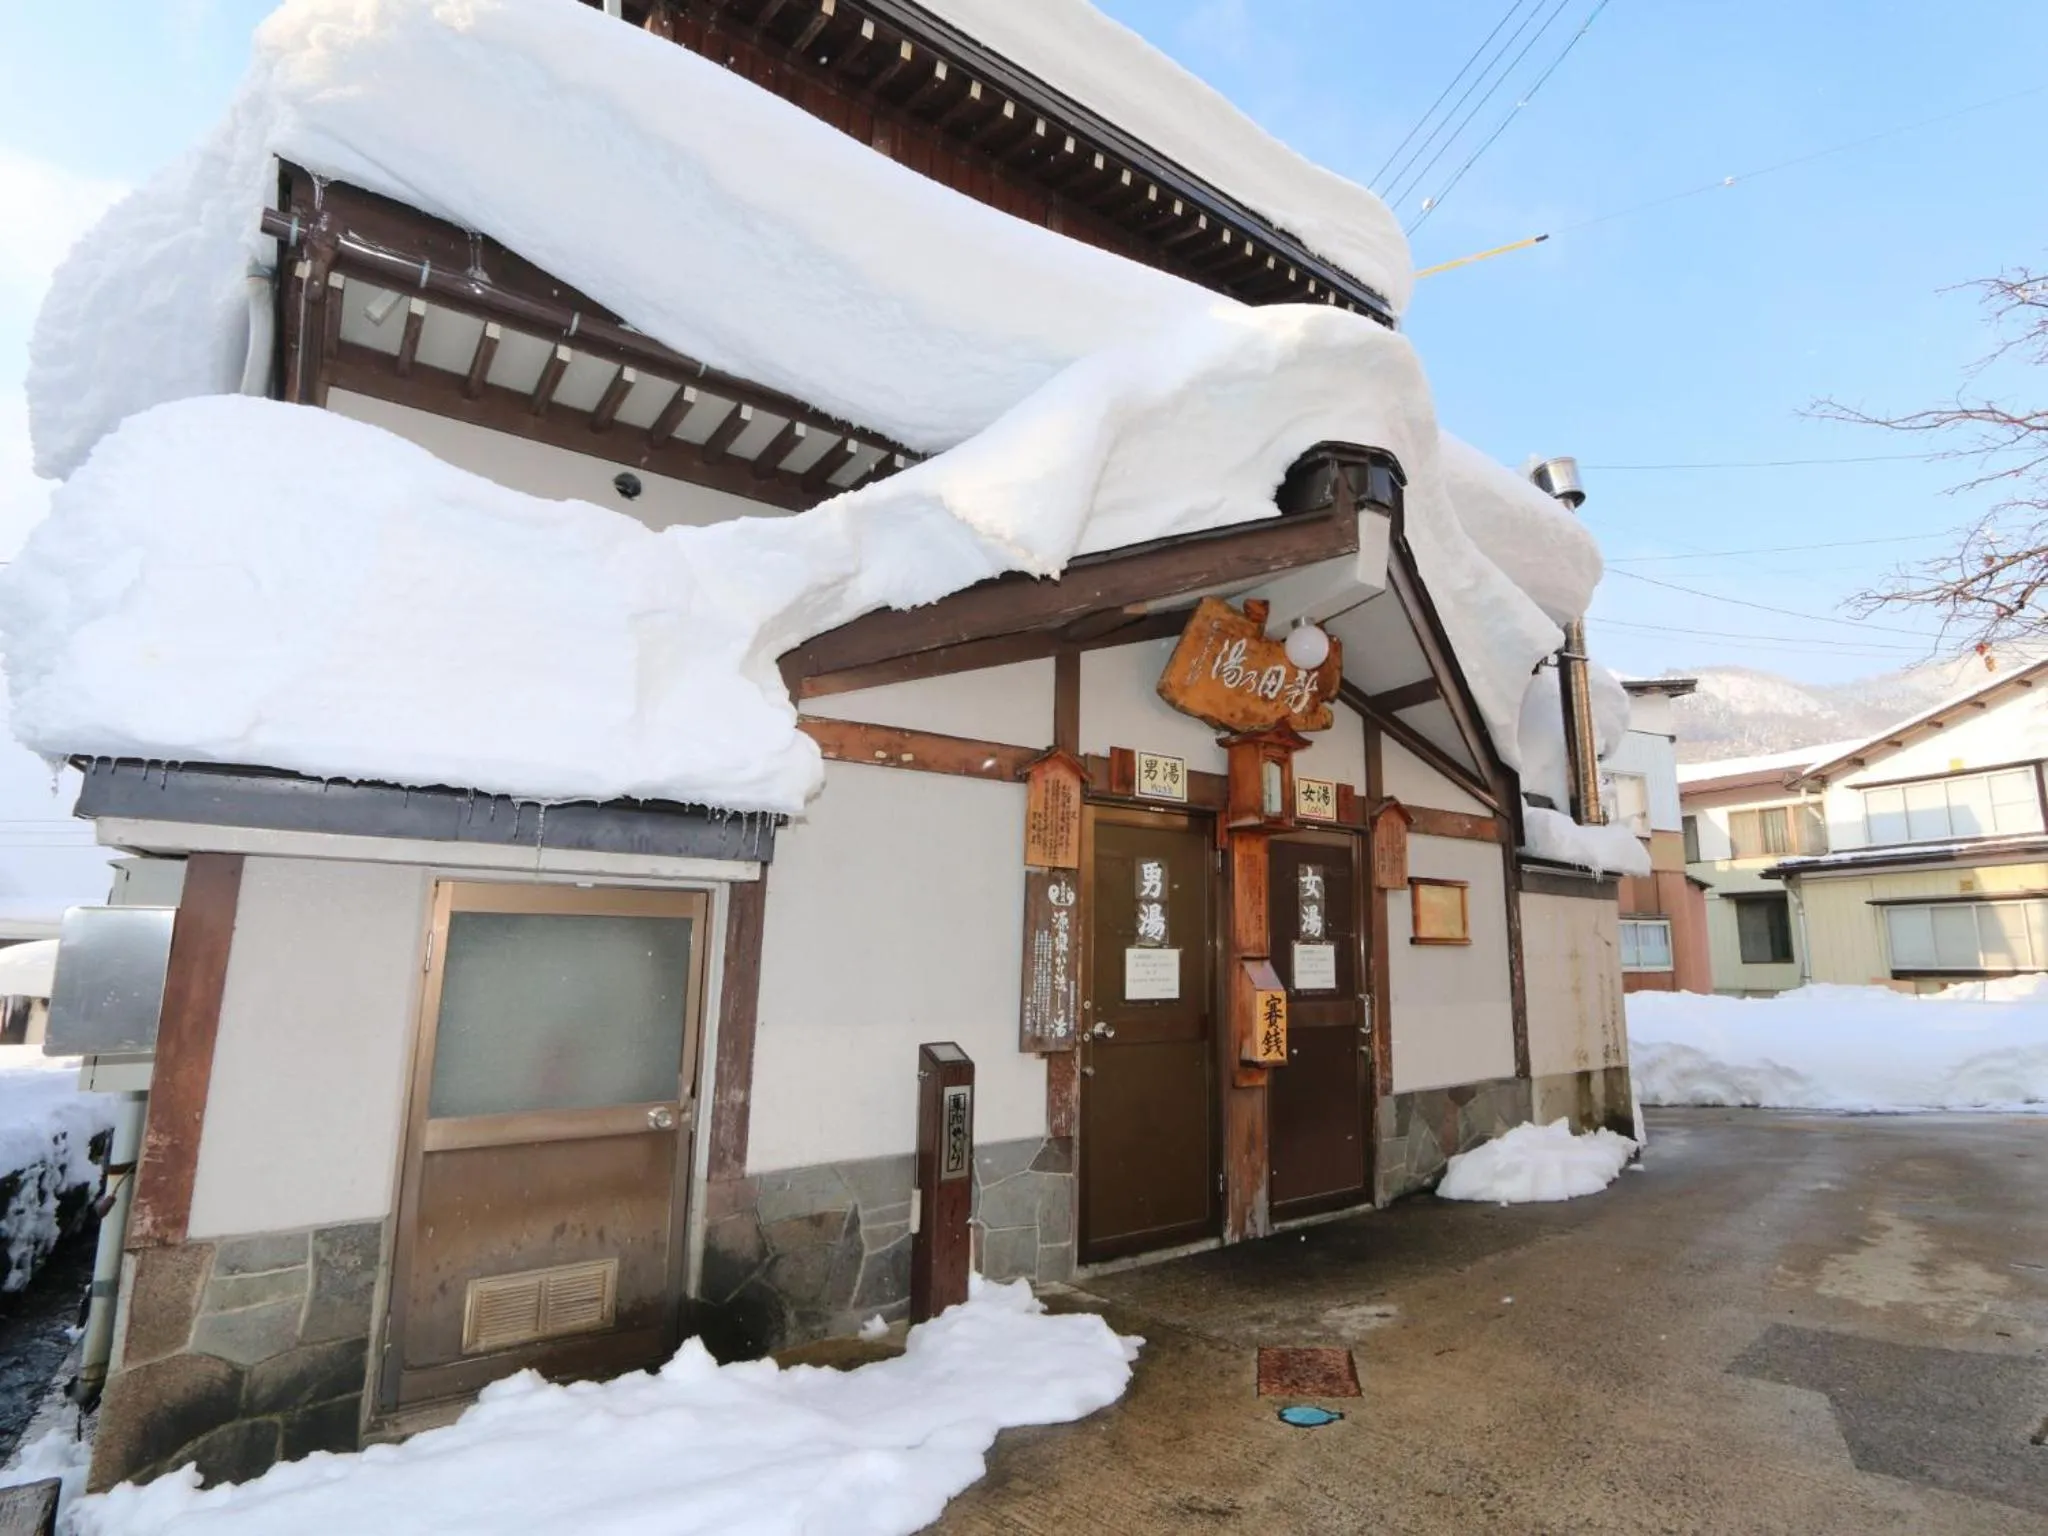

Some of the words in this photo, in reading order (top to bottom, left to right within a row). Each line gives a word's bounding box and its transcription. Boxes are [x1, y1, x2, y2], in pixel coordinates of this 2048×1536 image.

[1144, 759, 1180, 784] 男湯
[1301, 783, 1331, 806] 女湯
[1138, 862, 1166, 941] 男湯
[1300, 865, 1322, 937] 女湯
